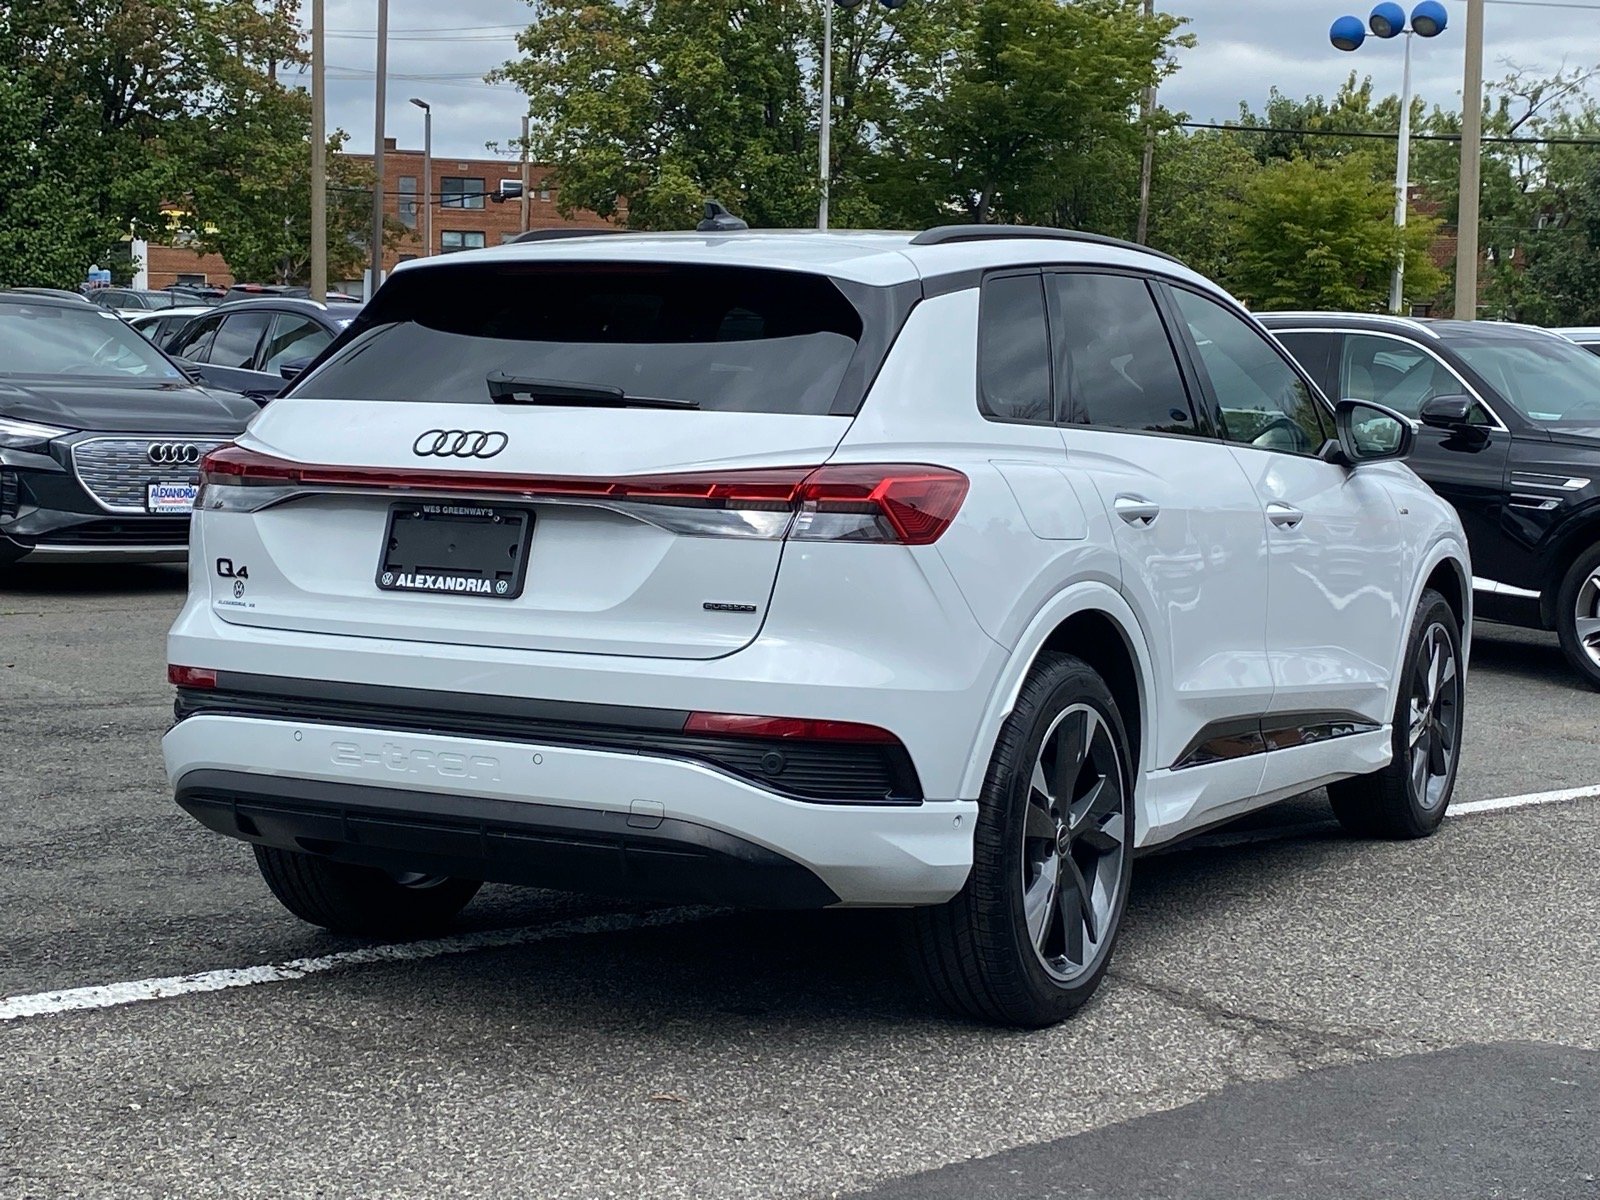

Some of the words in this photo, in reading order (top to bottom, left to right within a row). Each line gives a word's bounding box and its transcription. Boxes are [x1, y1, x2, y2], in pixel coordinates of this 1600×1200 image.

[151, 487, 198, 499] ALEXANDRIA
[423, 505, 441, 514] WES
[442, 506, 494, 517] GREENWAY'S
[216, 557, 249, 580] Q4
[395, 573, 492, 593] ALEXANDRIA
[705, 602, 754, 611] quattro
[329, 740, 501, 783] e-tron
